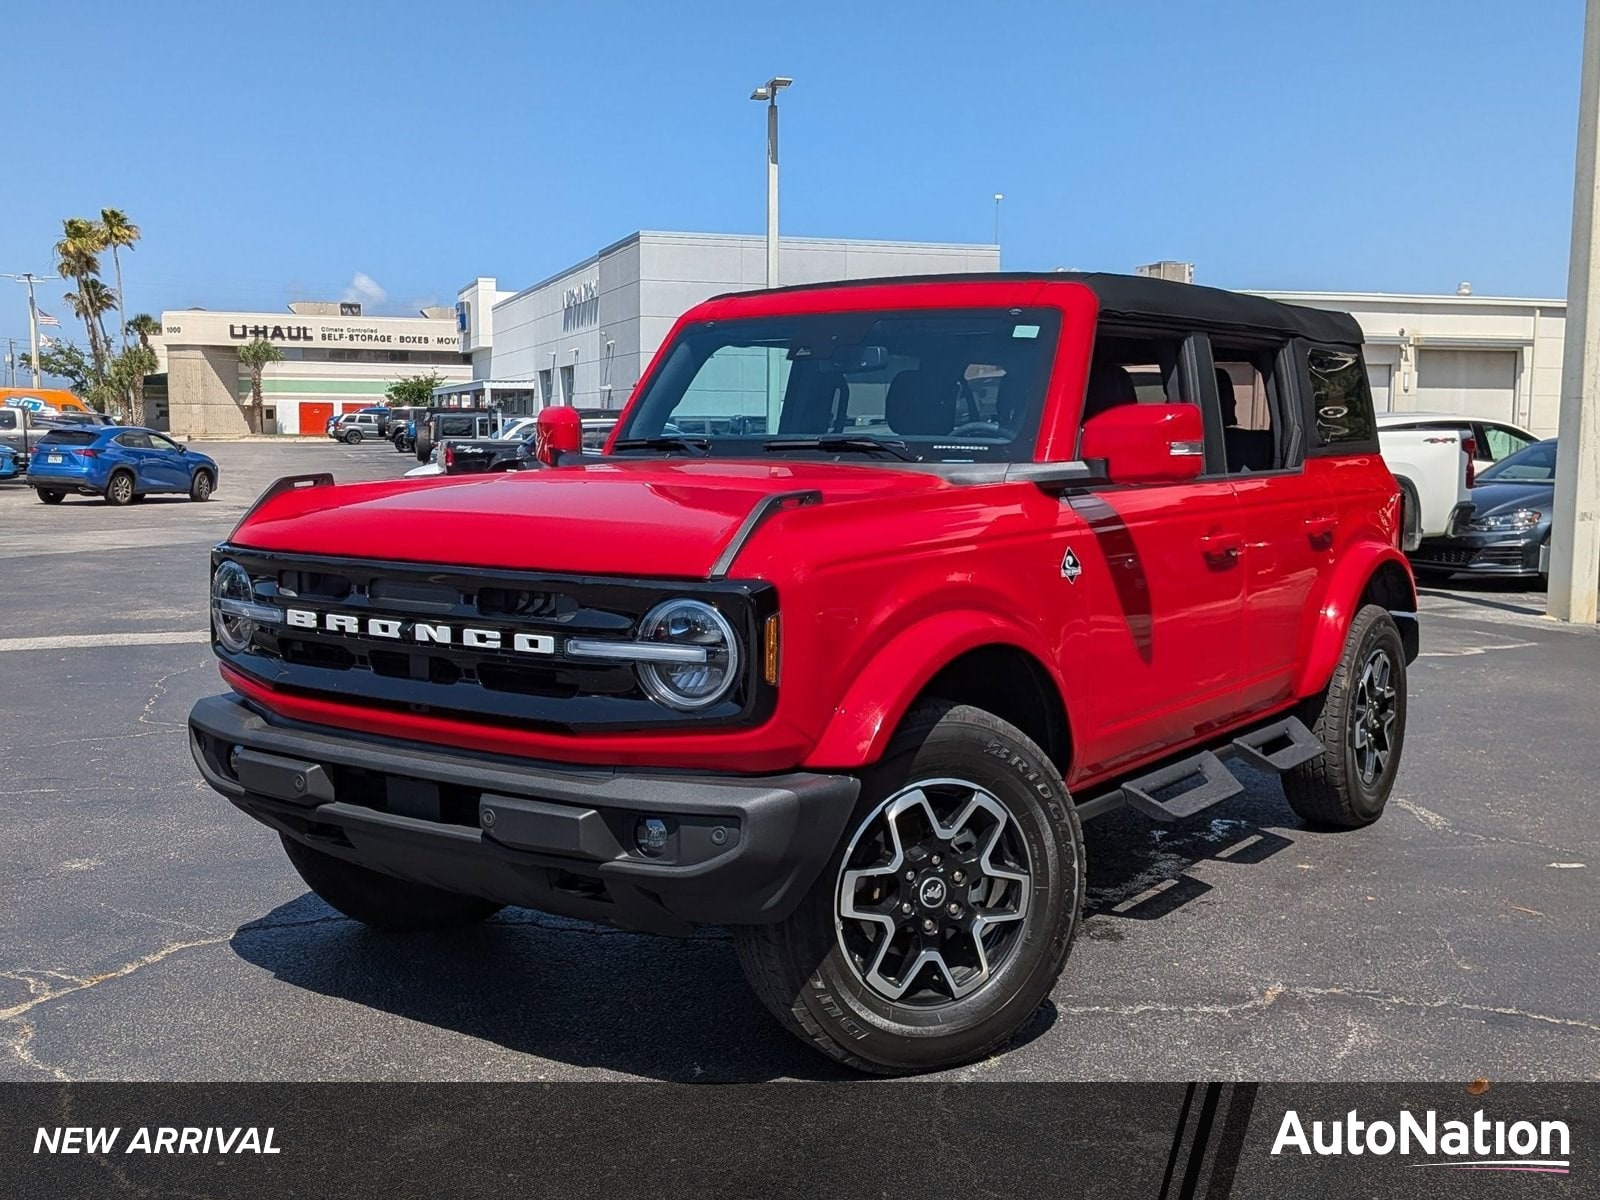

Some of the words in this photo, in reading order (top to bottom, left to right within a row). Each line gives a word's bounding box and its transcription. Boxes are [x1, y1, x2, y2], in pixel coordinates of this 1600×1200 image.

[166, 326, 181, 334] 1000
[229, 324, 313, 341] U-HAUL
[320, 333, 392, 343] SELF-STORAGE
[399, 335, 429, 345] BOXES
[286, 608, 555, 654] BRONCO
